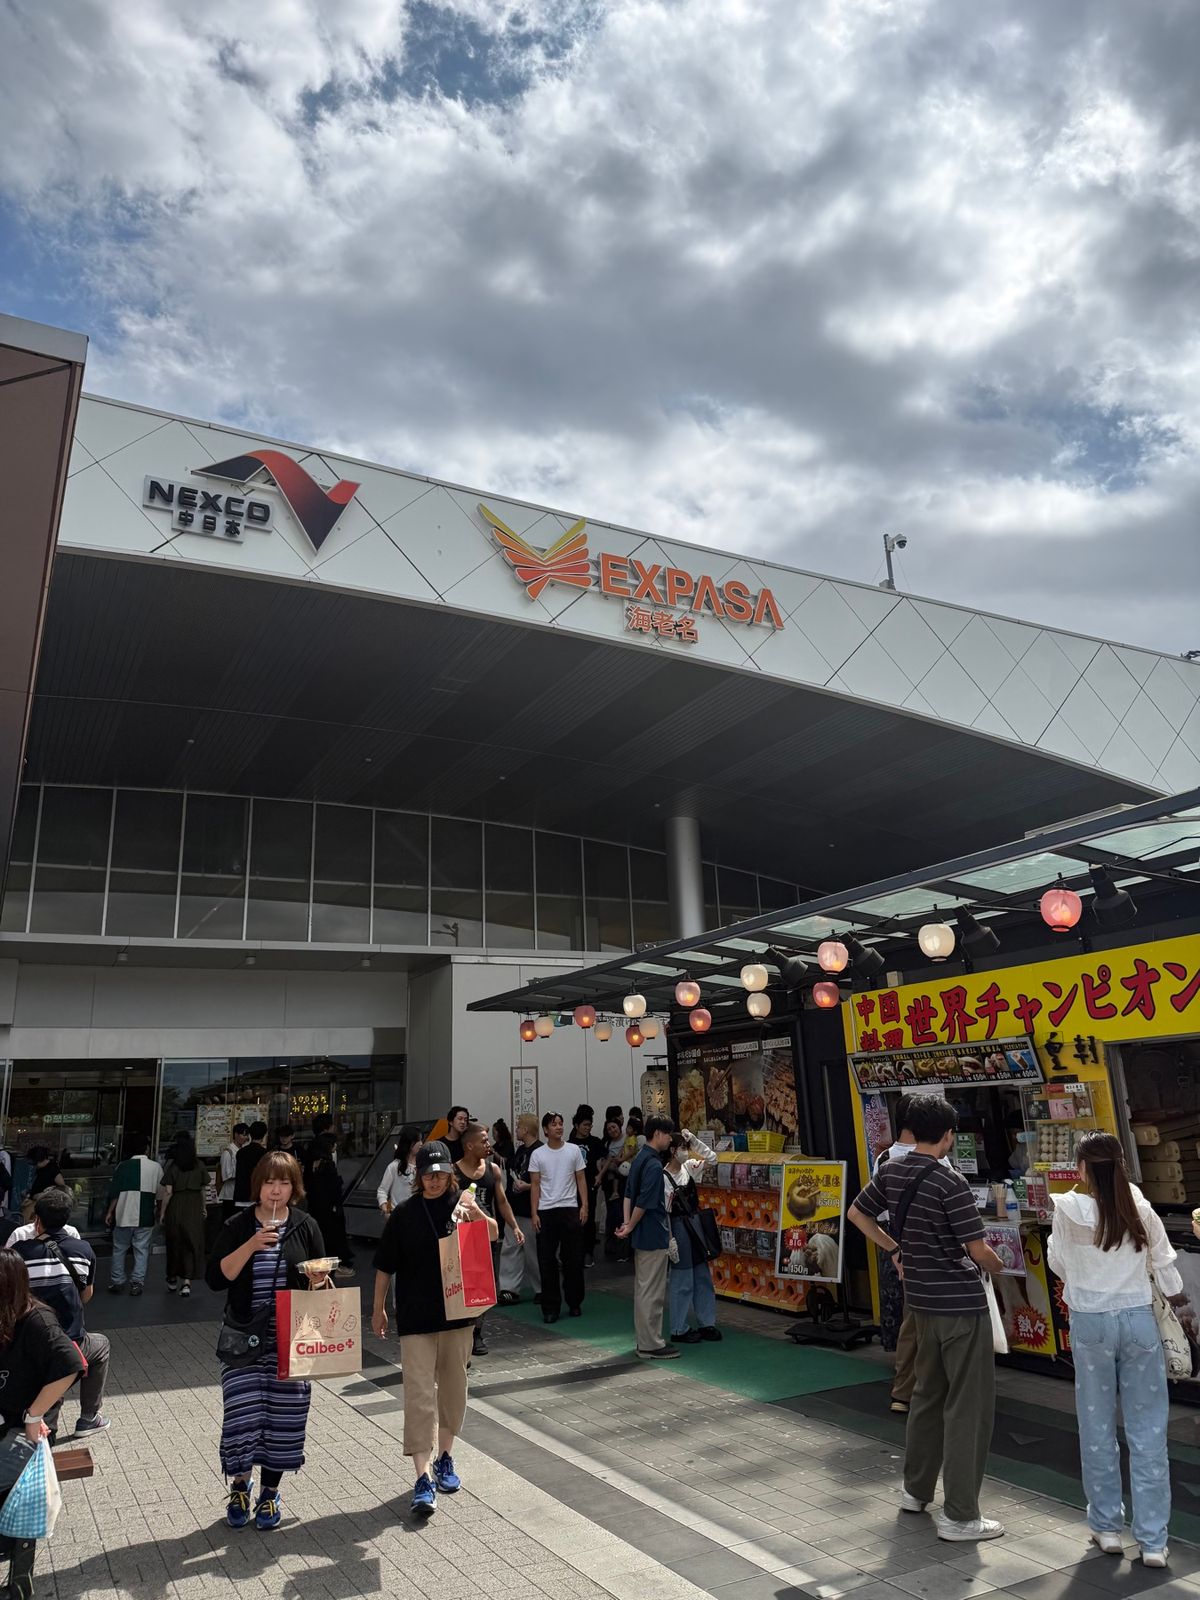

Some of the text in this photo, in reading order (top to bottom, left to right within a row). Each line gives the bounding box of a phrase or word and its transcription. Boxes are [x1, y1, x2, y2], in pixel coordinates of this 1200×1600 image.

[149, 480, 270, 523] NEXCO
[178, 510, 241, 536] 中日本
[601, 552, 785, 631] EXPASA
[627, 604, 698, 642] 海老名
[856, 990, 901, 1027] 中国
[904, 958, 1200, 1046] 世界チャンピオン
[860, 1028, 903, 1051] 料理
[645, 1080, 654, 1113] 牛ハラミ
[656, 1078, 666, 1114] 牛カルビ
[789, 1239, 802, 1247] BIG
[1017, 1314, 1046, 1339] 熱々
